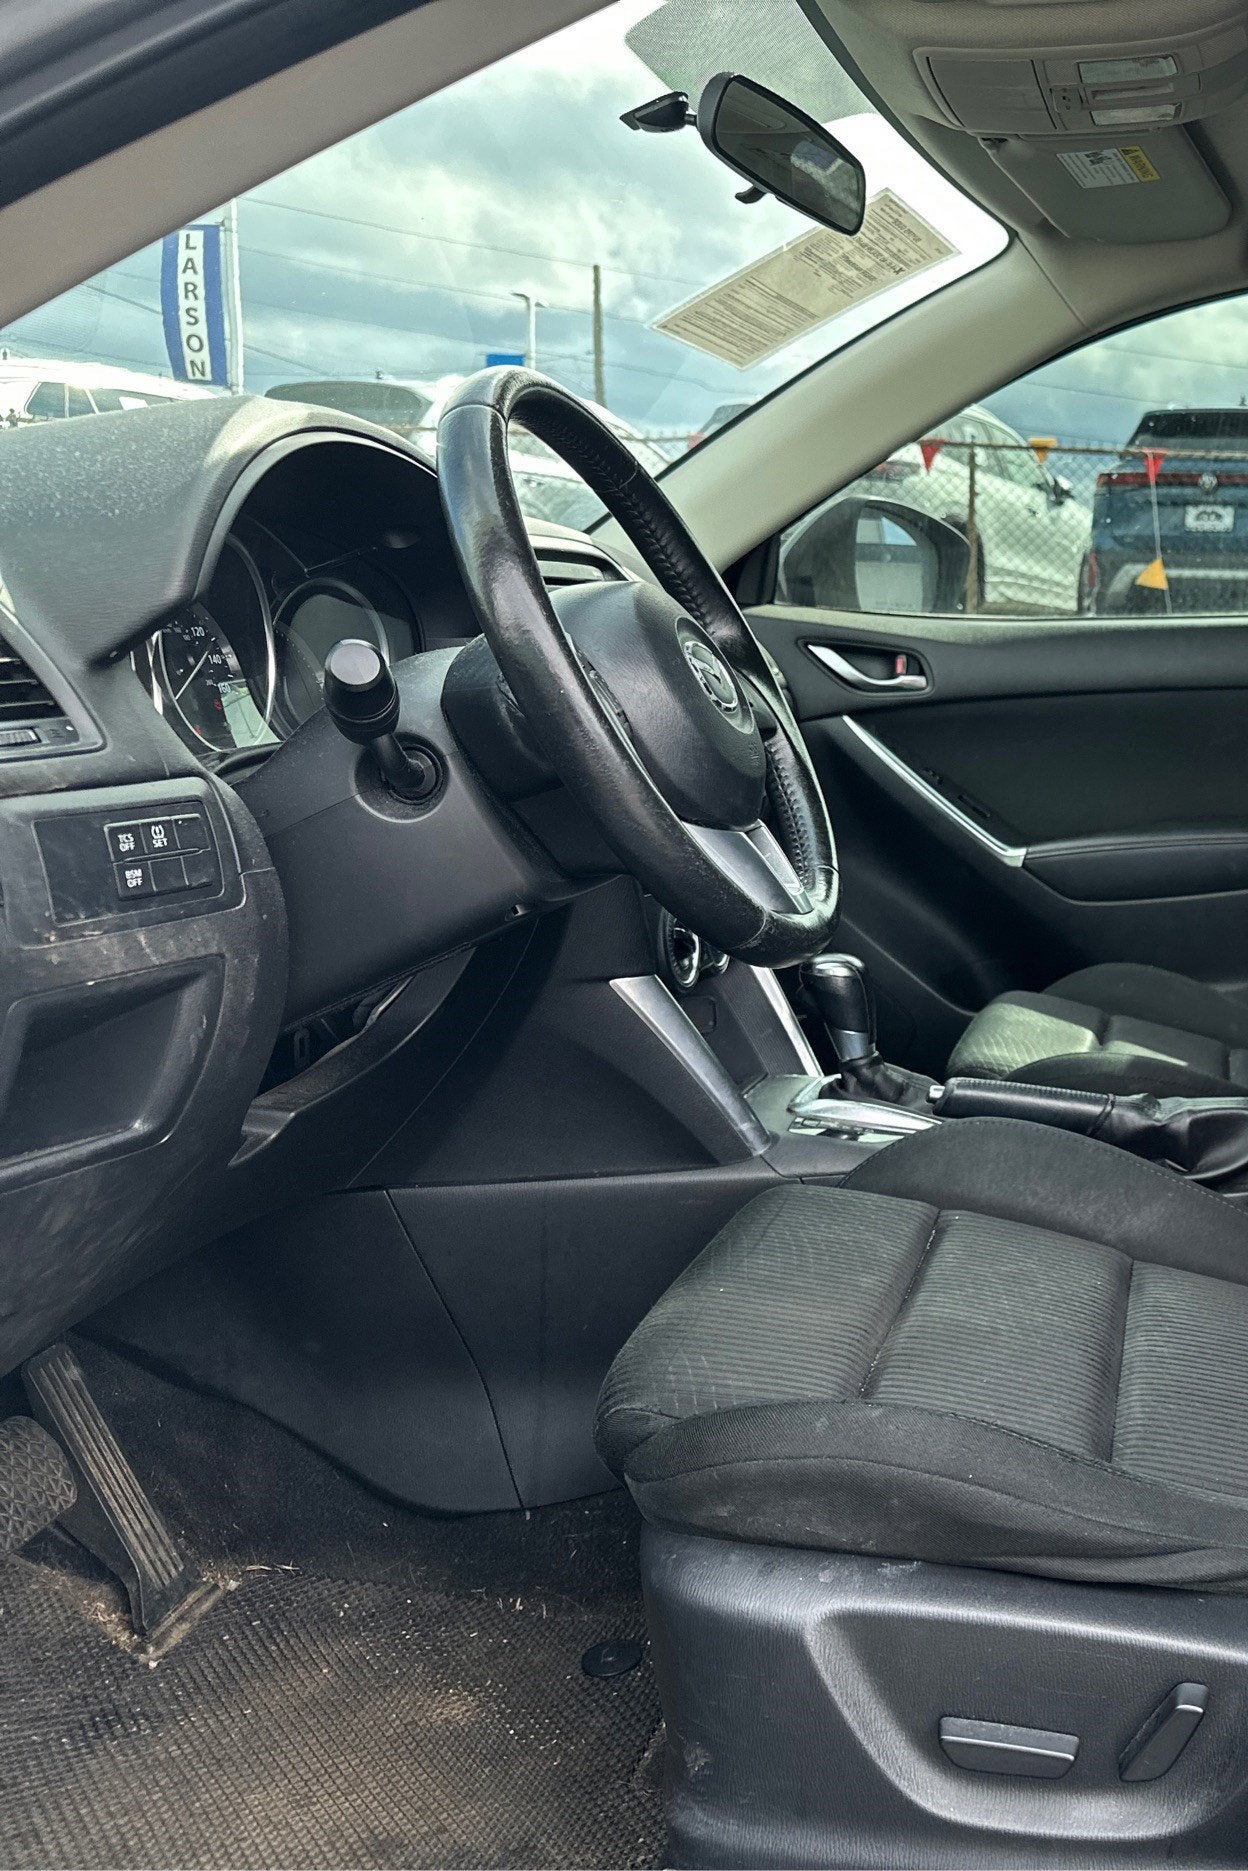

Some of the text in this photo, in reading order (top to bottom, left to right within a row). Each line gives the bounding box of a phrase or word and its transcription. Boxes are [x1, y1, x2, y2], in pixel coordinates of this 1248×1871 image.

[182, 233, 206, 377] LARSON
[191, 626, 205, 637] 120
[208, 654, 222, 665] 140
[217, 682, 231, 694] 160
[118, 833, 135, 842] TCS
[119, 842, 135, 852] OFF
[152, 838, 168, 848] SET
[126, 878, 143, 888] OFF
